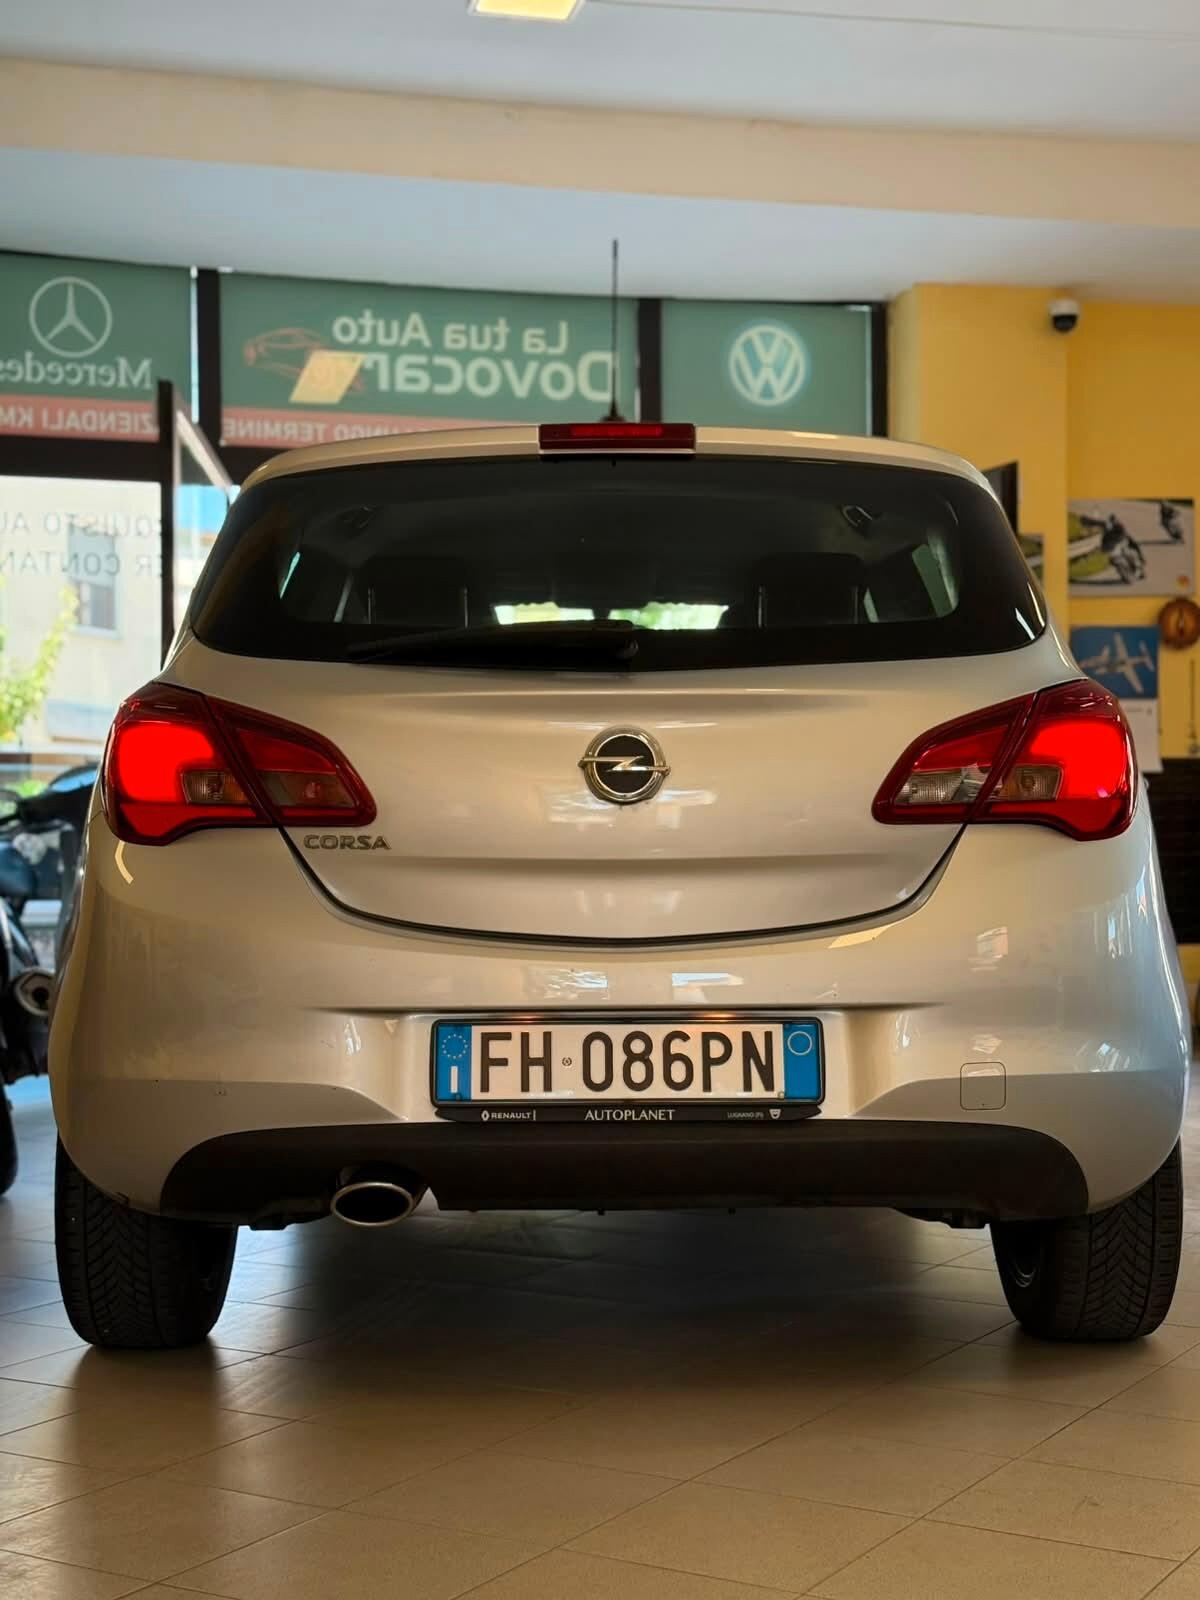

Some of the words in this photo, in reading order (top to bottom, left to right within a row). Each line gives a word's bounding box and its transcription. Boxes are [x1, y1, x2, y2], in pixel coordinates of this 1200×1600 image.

[303, 834, 391, 850] CORSA
[480, 1030, 552, 1093] FH
[582, 1030, 775, 1093] 086PN
[584, 1109, 676, 1121] AUTOPLANET
